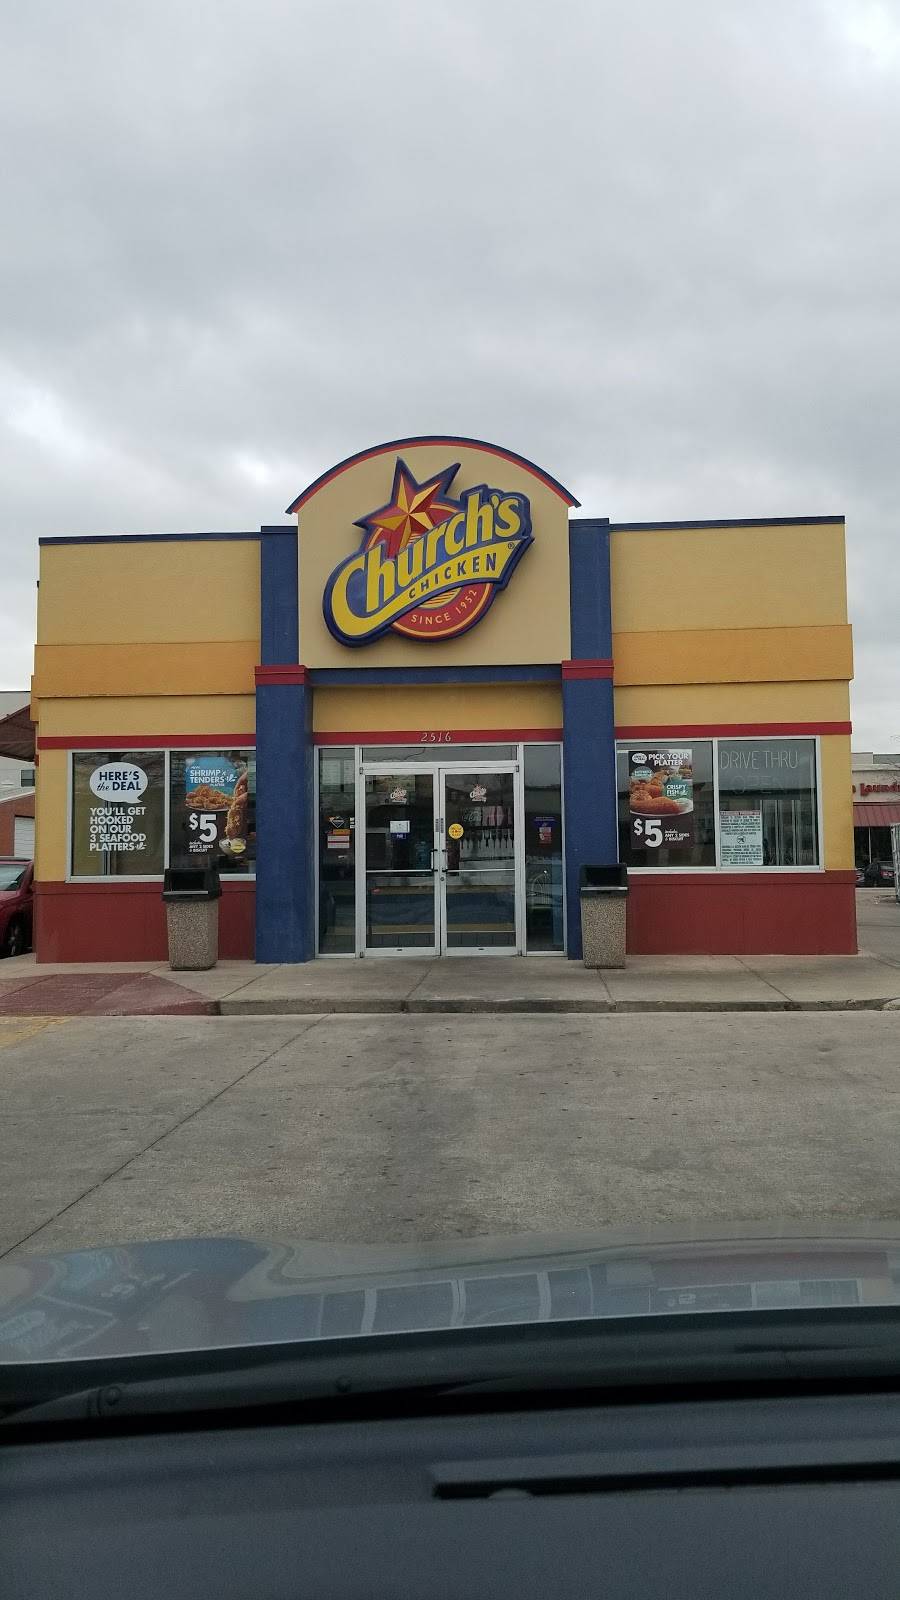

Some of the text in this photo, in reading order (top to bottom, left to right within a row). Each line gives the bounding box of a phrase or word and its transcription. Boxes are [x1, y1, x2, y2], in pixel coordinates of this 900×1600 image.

[331, 493, 521, 636] Church's
[408, 553, 497, 599] CHICKEN
[411, 590, 477, 625] SINCE 1952
[420, 732, 452, 742] 2516
[648, 753, 666, 761] PICK
[667, 752, 689, 760] YOUR
[720, 750, 799, 770] DRIVE THRU
[99, 771, 139, 781] HERE'S
[190, 769, 221, 777] SHRIMP
[190, 776, 225, 784] TENDERS
[96, 781, 141, 791] the DEAL
[89, 806, 146, 816] YOU'LL GET
[89, 816, 134, 825] HOOKED
[89, 824, 132, 834] ON OUR
[189, 812, 218, 843] $5
[89, 833, 146, 842] 3 SEAFOOD
[633, 818, 664, 848] $5
[89, 842, 135, 851] PLATTERS
